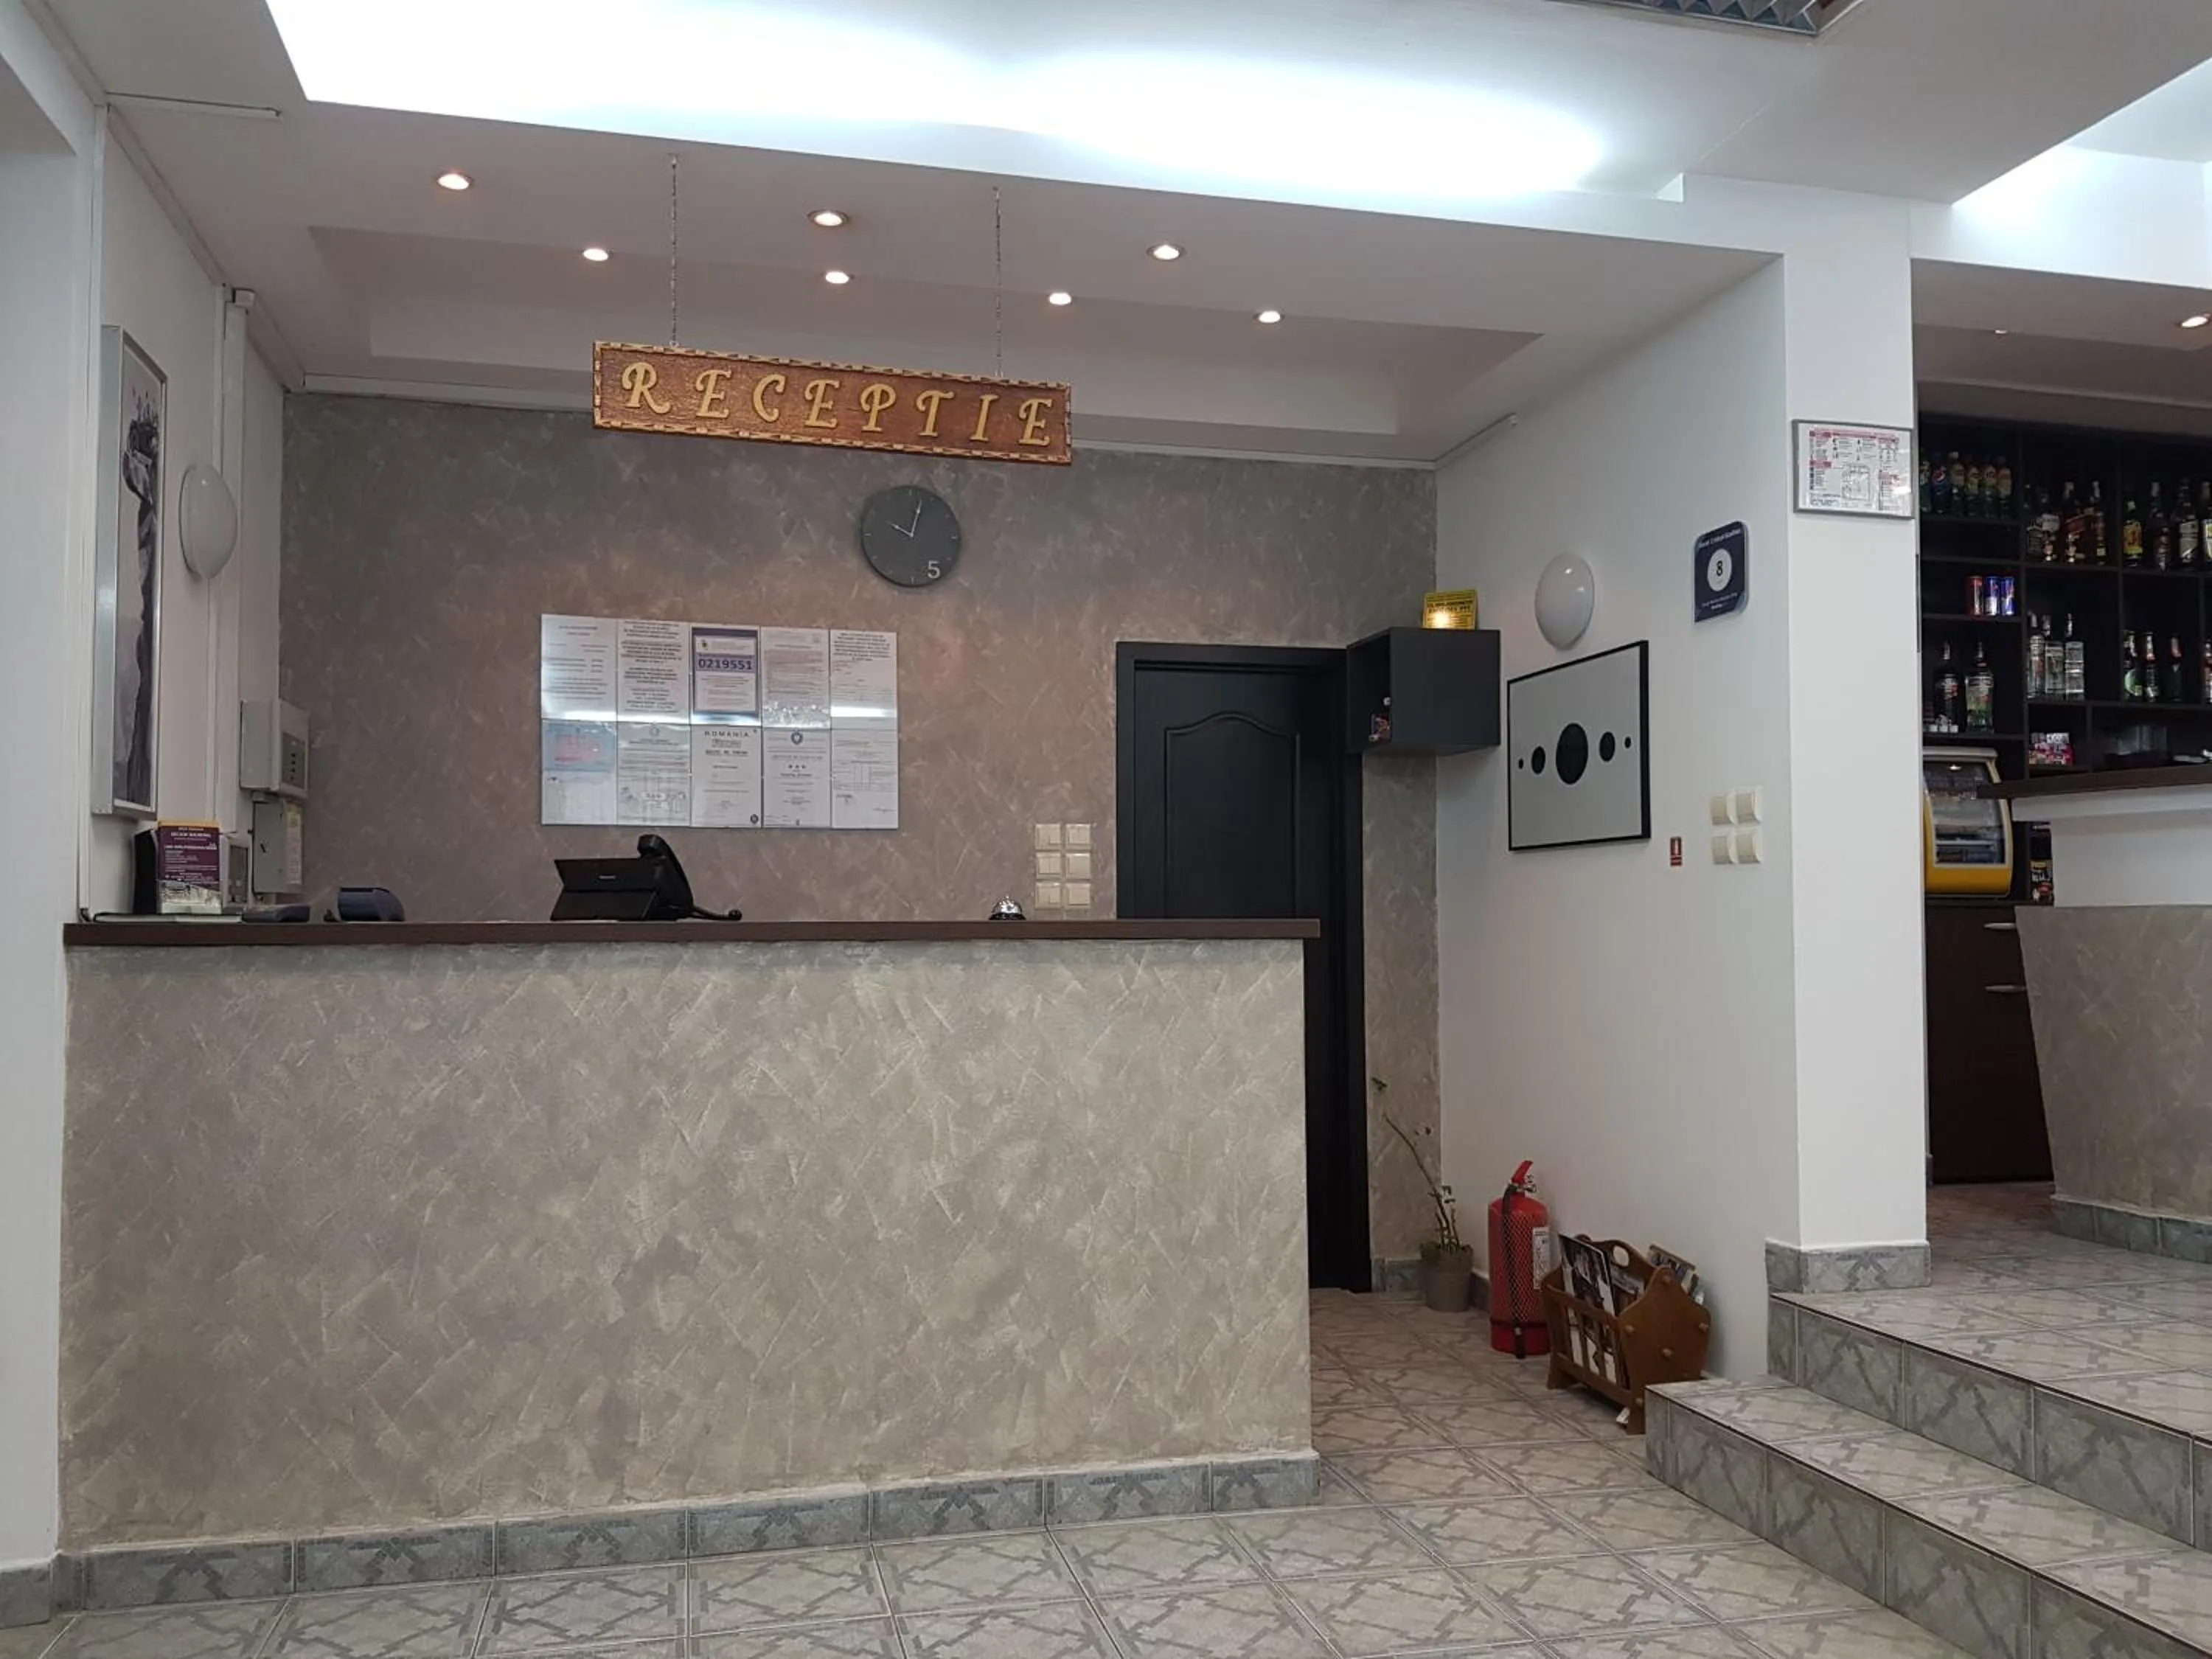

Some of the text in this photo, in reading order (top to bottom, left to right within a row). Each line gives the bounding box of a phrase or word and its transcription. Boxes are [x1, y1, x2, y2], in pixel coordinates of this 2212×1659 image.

[622, 362, 1052, 445] RECEPTIE
[928, 560, 940, 579] 5
[698, 659, 753, 670] 0219551
